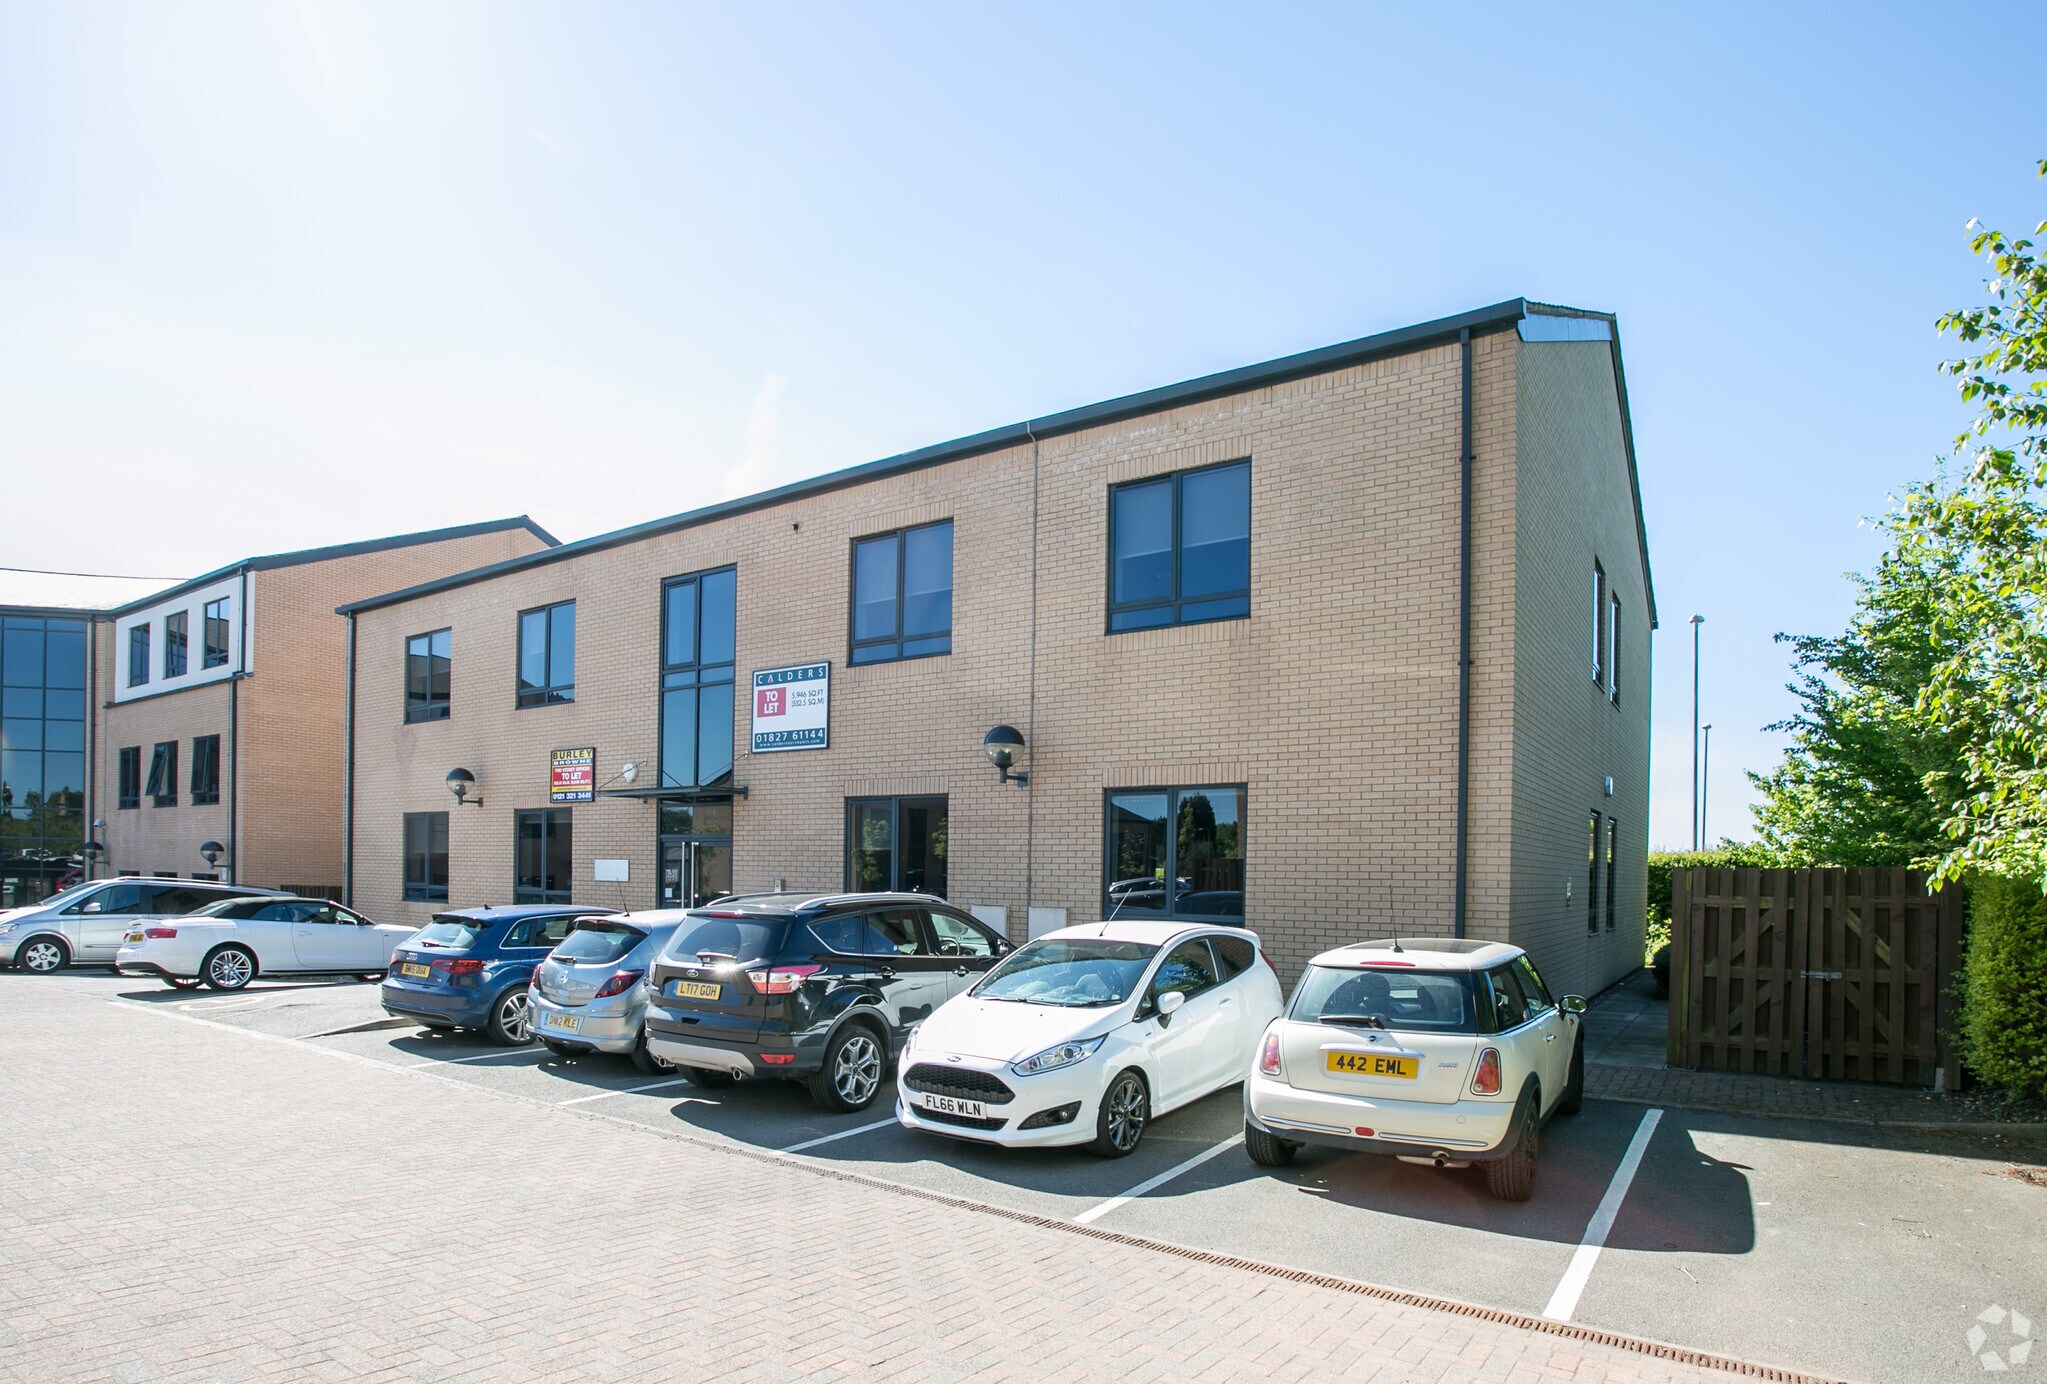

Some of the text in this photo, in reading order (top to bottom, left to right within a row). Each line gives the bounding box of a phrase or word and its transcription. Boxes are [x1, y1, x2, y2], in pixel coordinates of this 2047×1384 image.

[757, 667, 824, 684] CALDERS
[765, 690, 778, 702] TO
[764, 702, 779, 715] LET
[756, 729, 824, 743] 01827 61144
[552, 749, 592, 760] BURLEY
[561, 772, 582, 780] TO LET
[566, 792, 576, 800] 321
[679, 982, 699, 995] LT17
[1336, 1055, 1407, 1076] 442 EML
[925, 1094, 981, 1116] FL66 WLN
